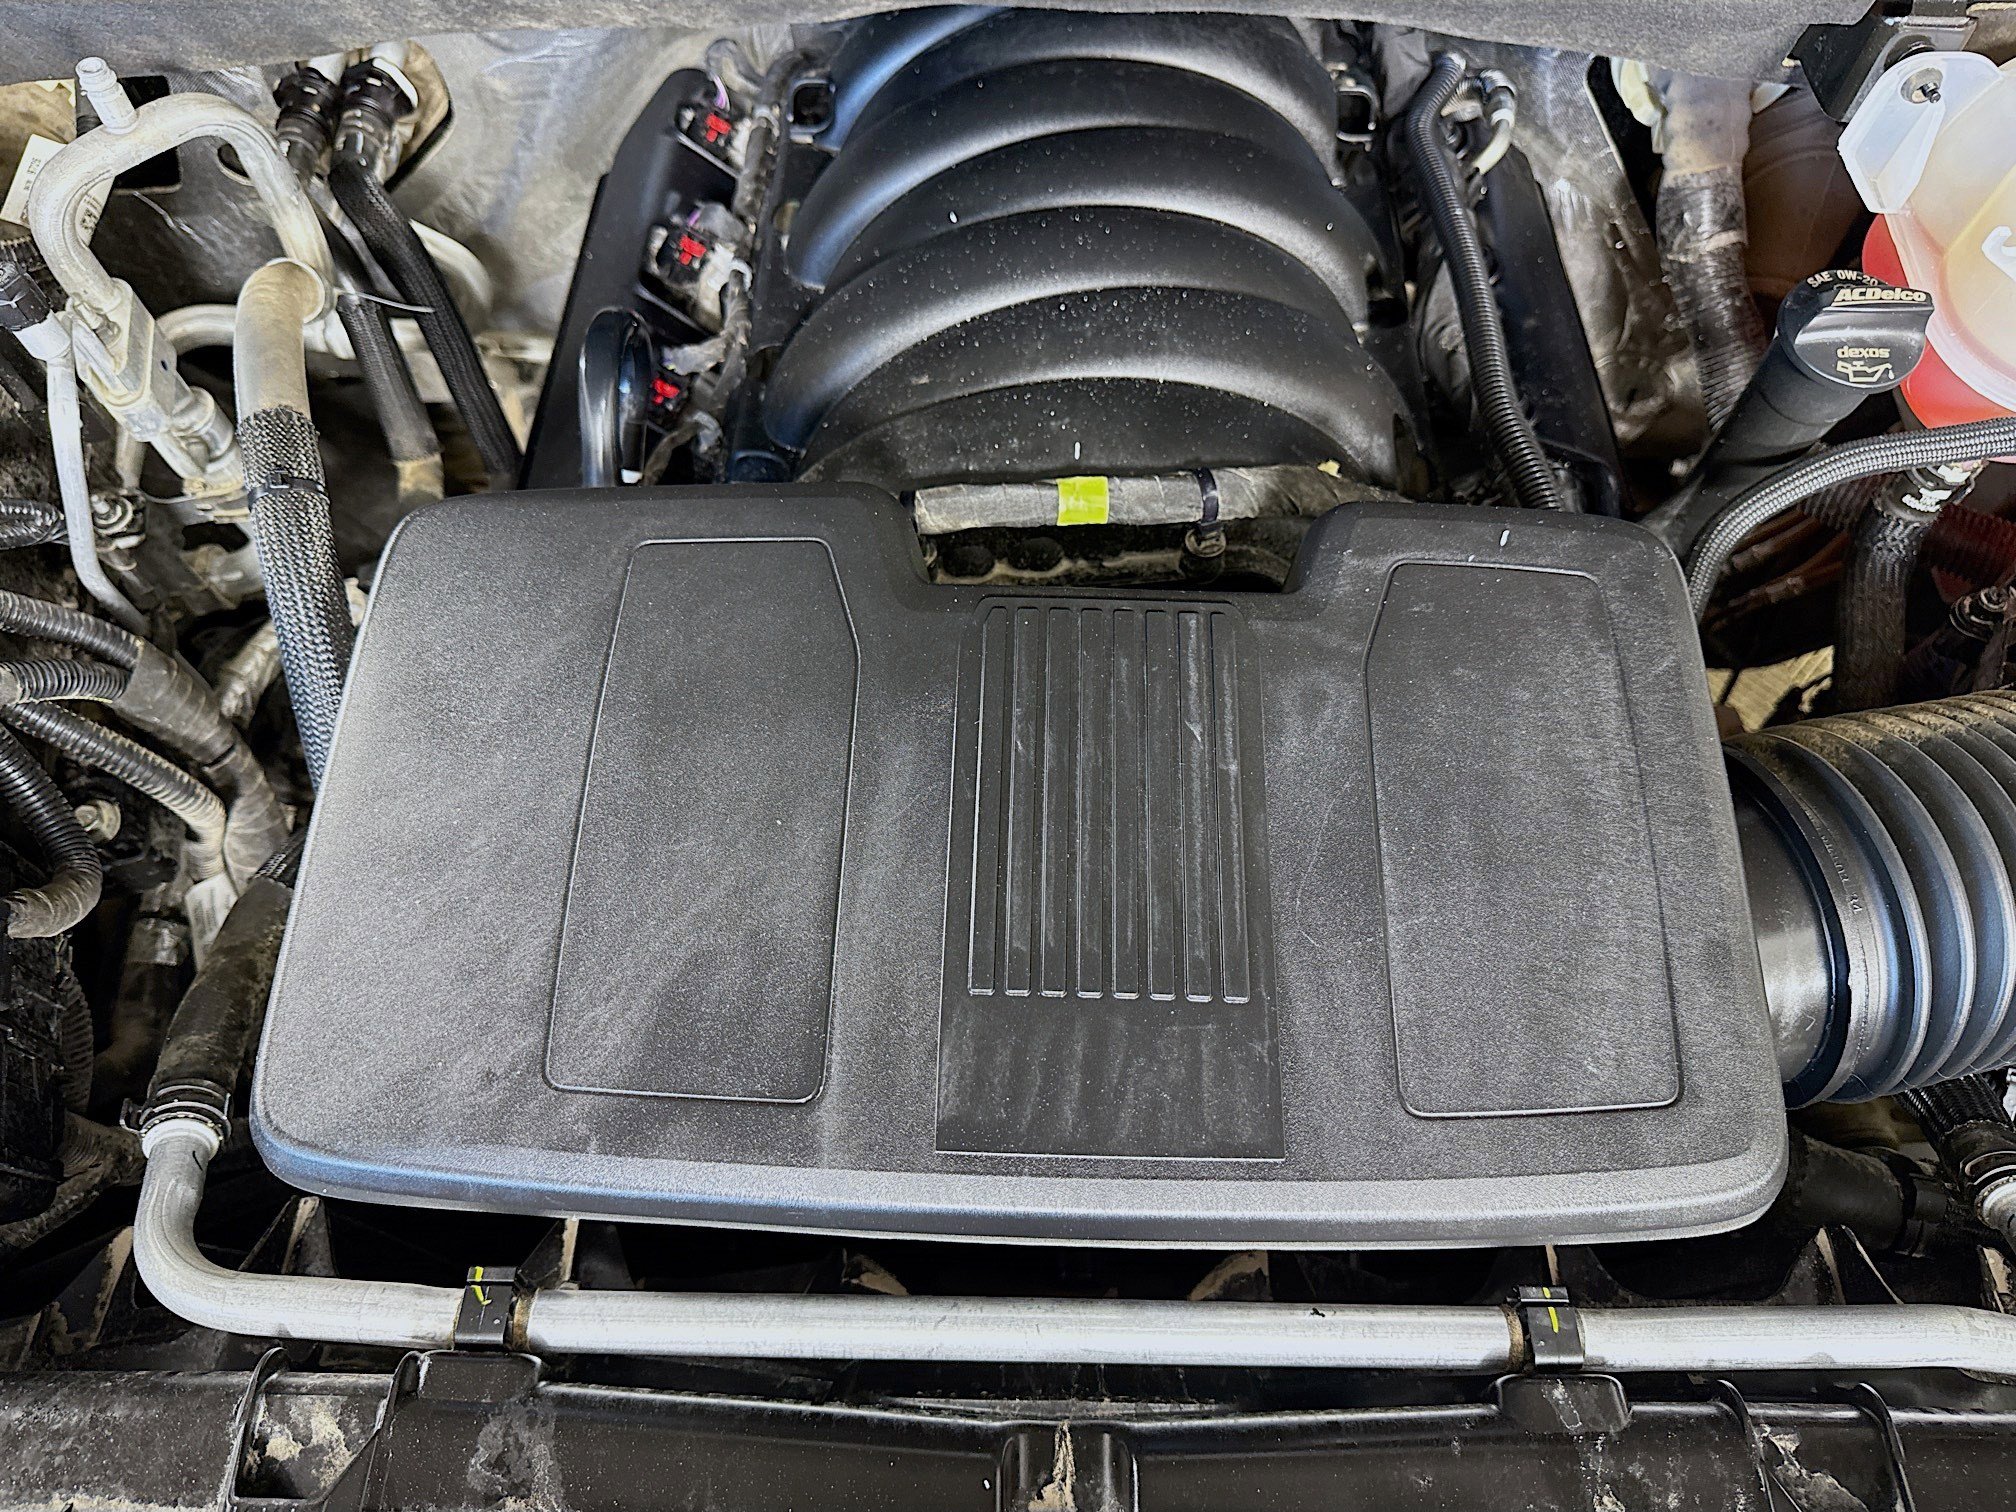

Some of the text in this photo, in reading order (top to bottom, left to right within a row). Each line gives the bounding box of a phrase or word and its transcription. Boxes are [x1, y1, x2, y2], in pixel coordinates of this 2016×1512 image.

[1806, 269, 1879, 288] SAE 0W-20
[1833, 287, 1927, 302] ACDelco
[1836, 345, 1891, 359] dexos
